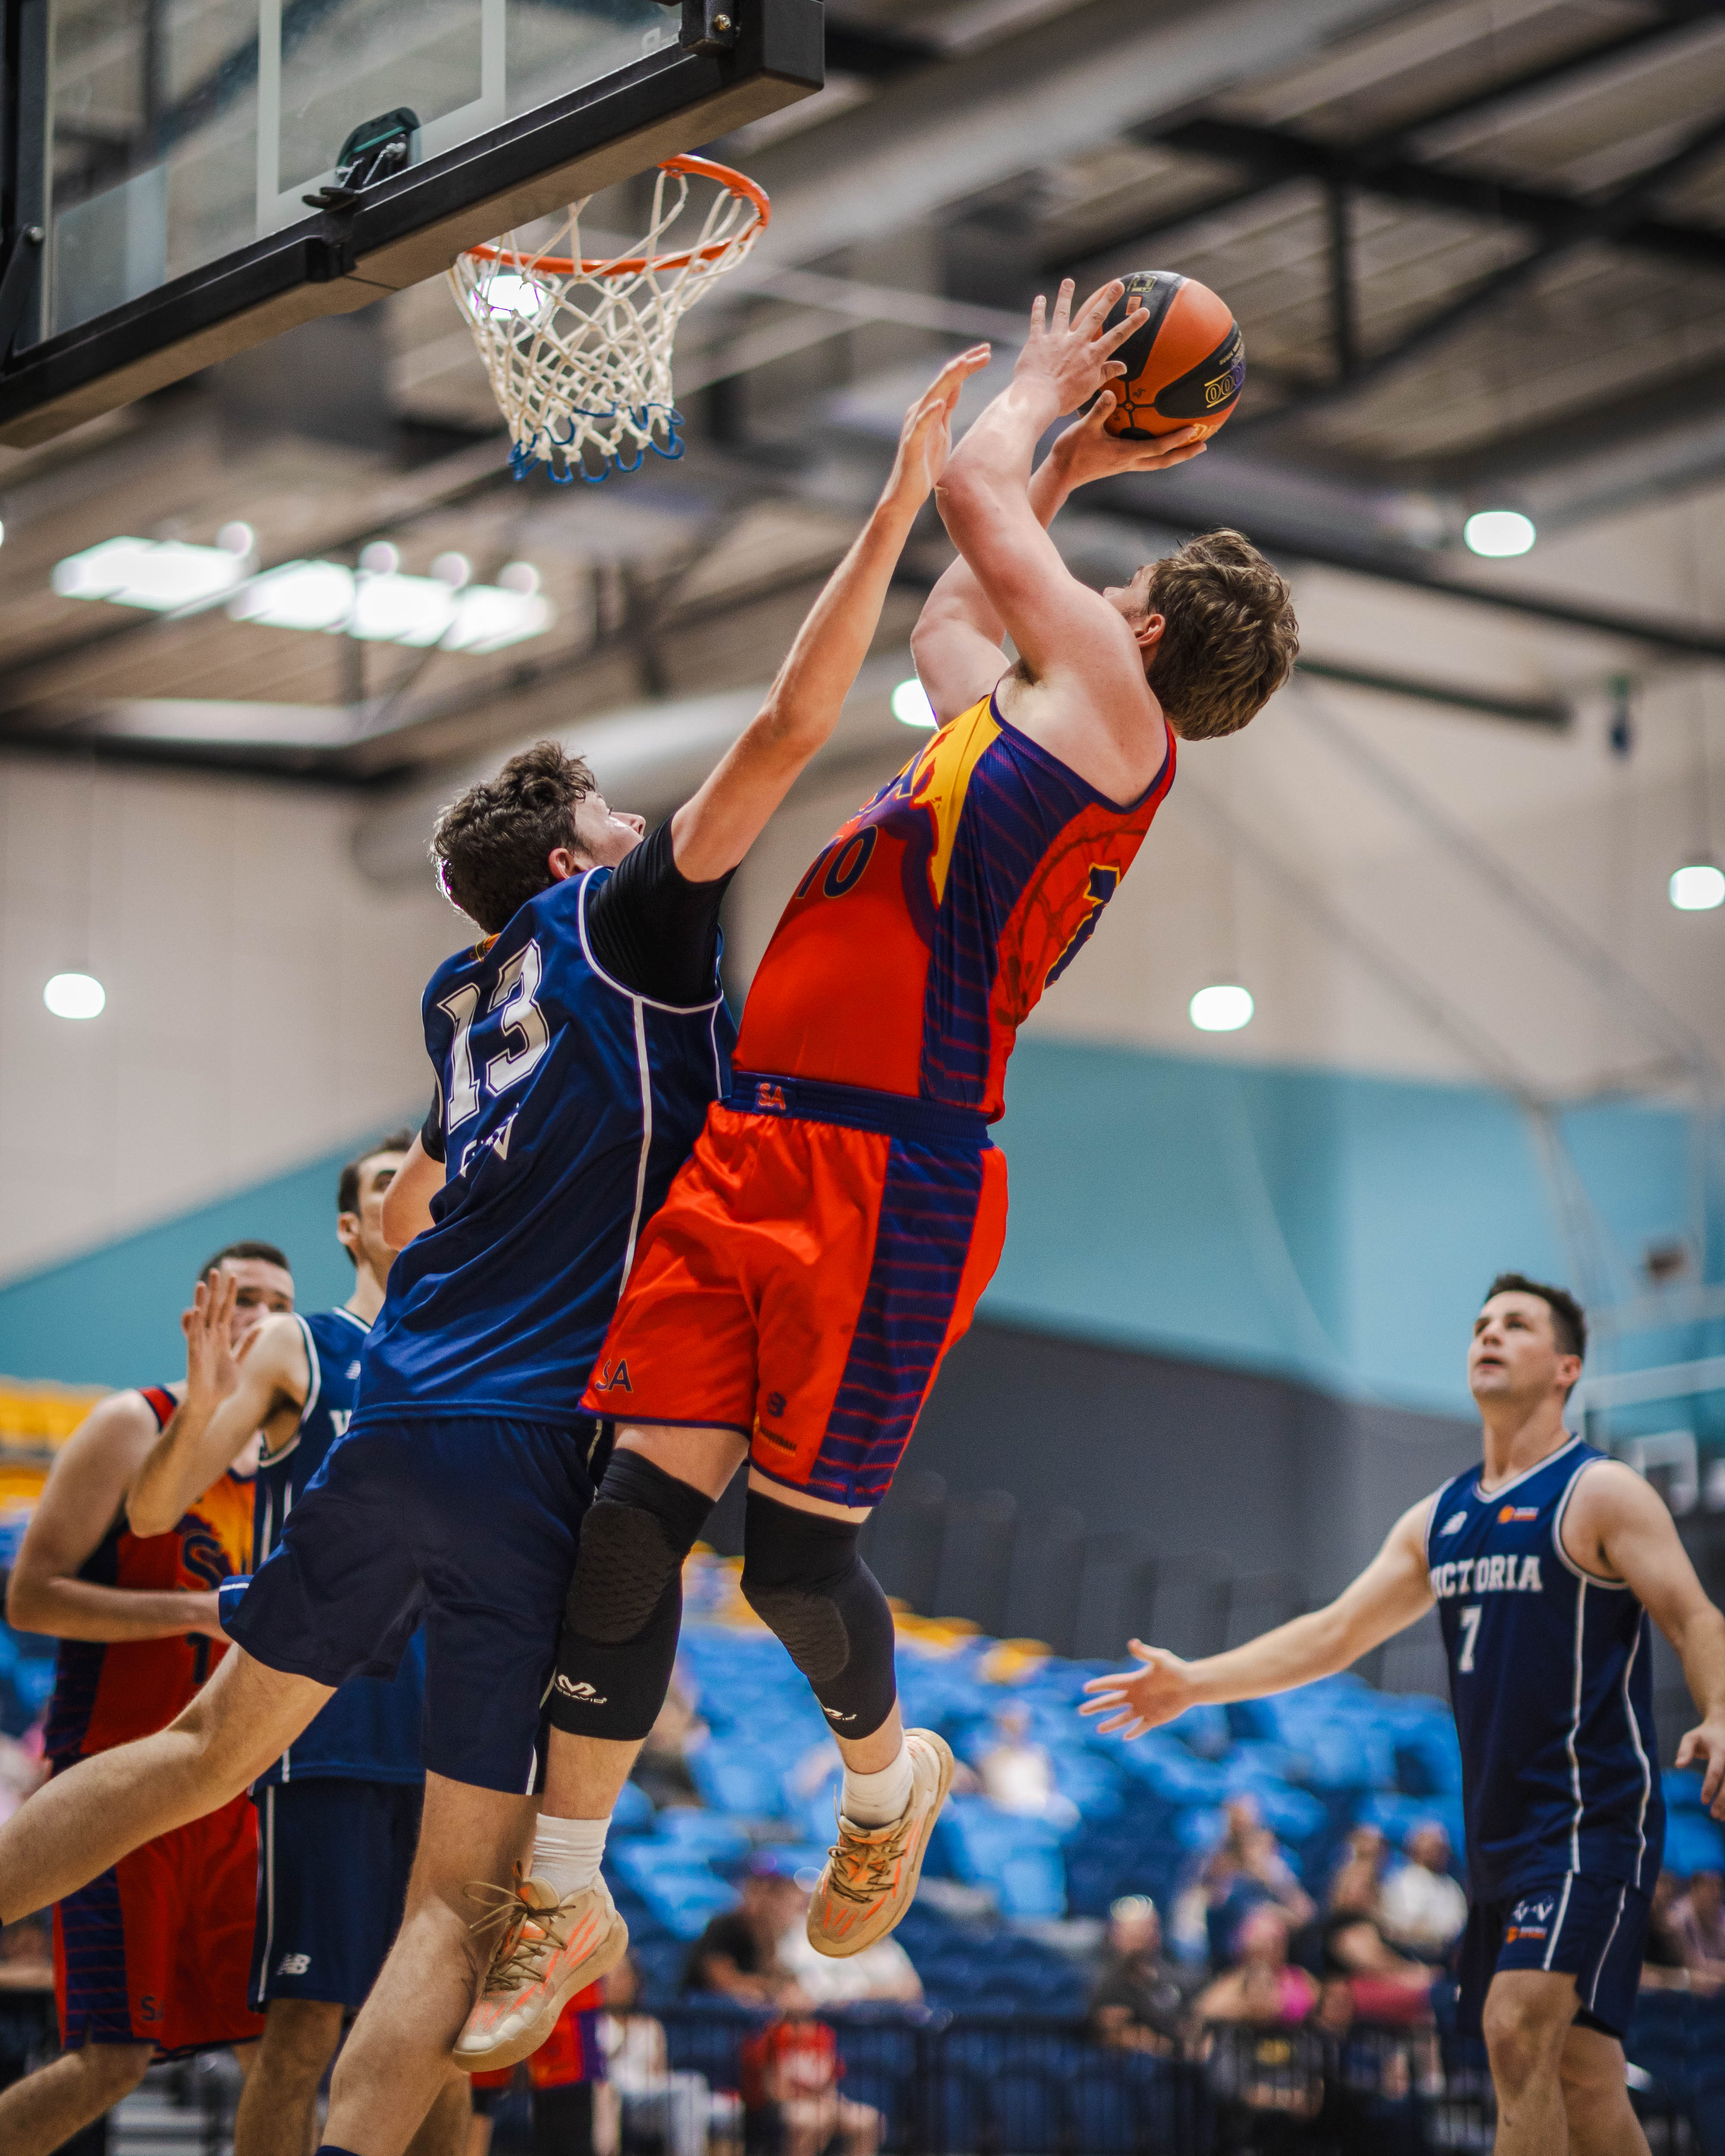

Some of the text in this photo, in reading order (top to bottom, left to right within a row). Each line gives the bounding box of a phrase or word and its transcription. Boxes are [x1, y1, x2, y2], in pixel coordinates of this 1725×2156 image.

[796, 824, 878, 899] 10
[437, 937, 550, 1135] 13
[759, 1083, 786, 1110] SA
[595, 1358, 634, 1393] SA
[1458, 1605, 1483, 1672] 7
[555, 1683, 605, 1704] CDAVID
